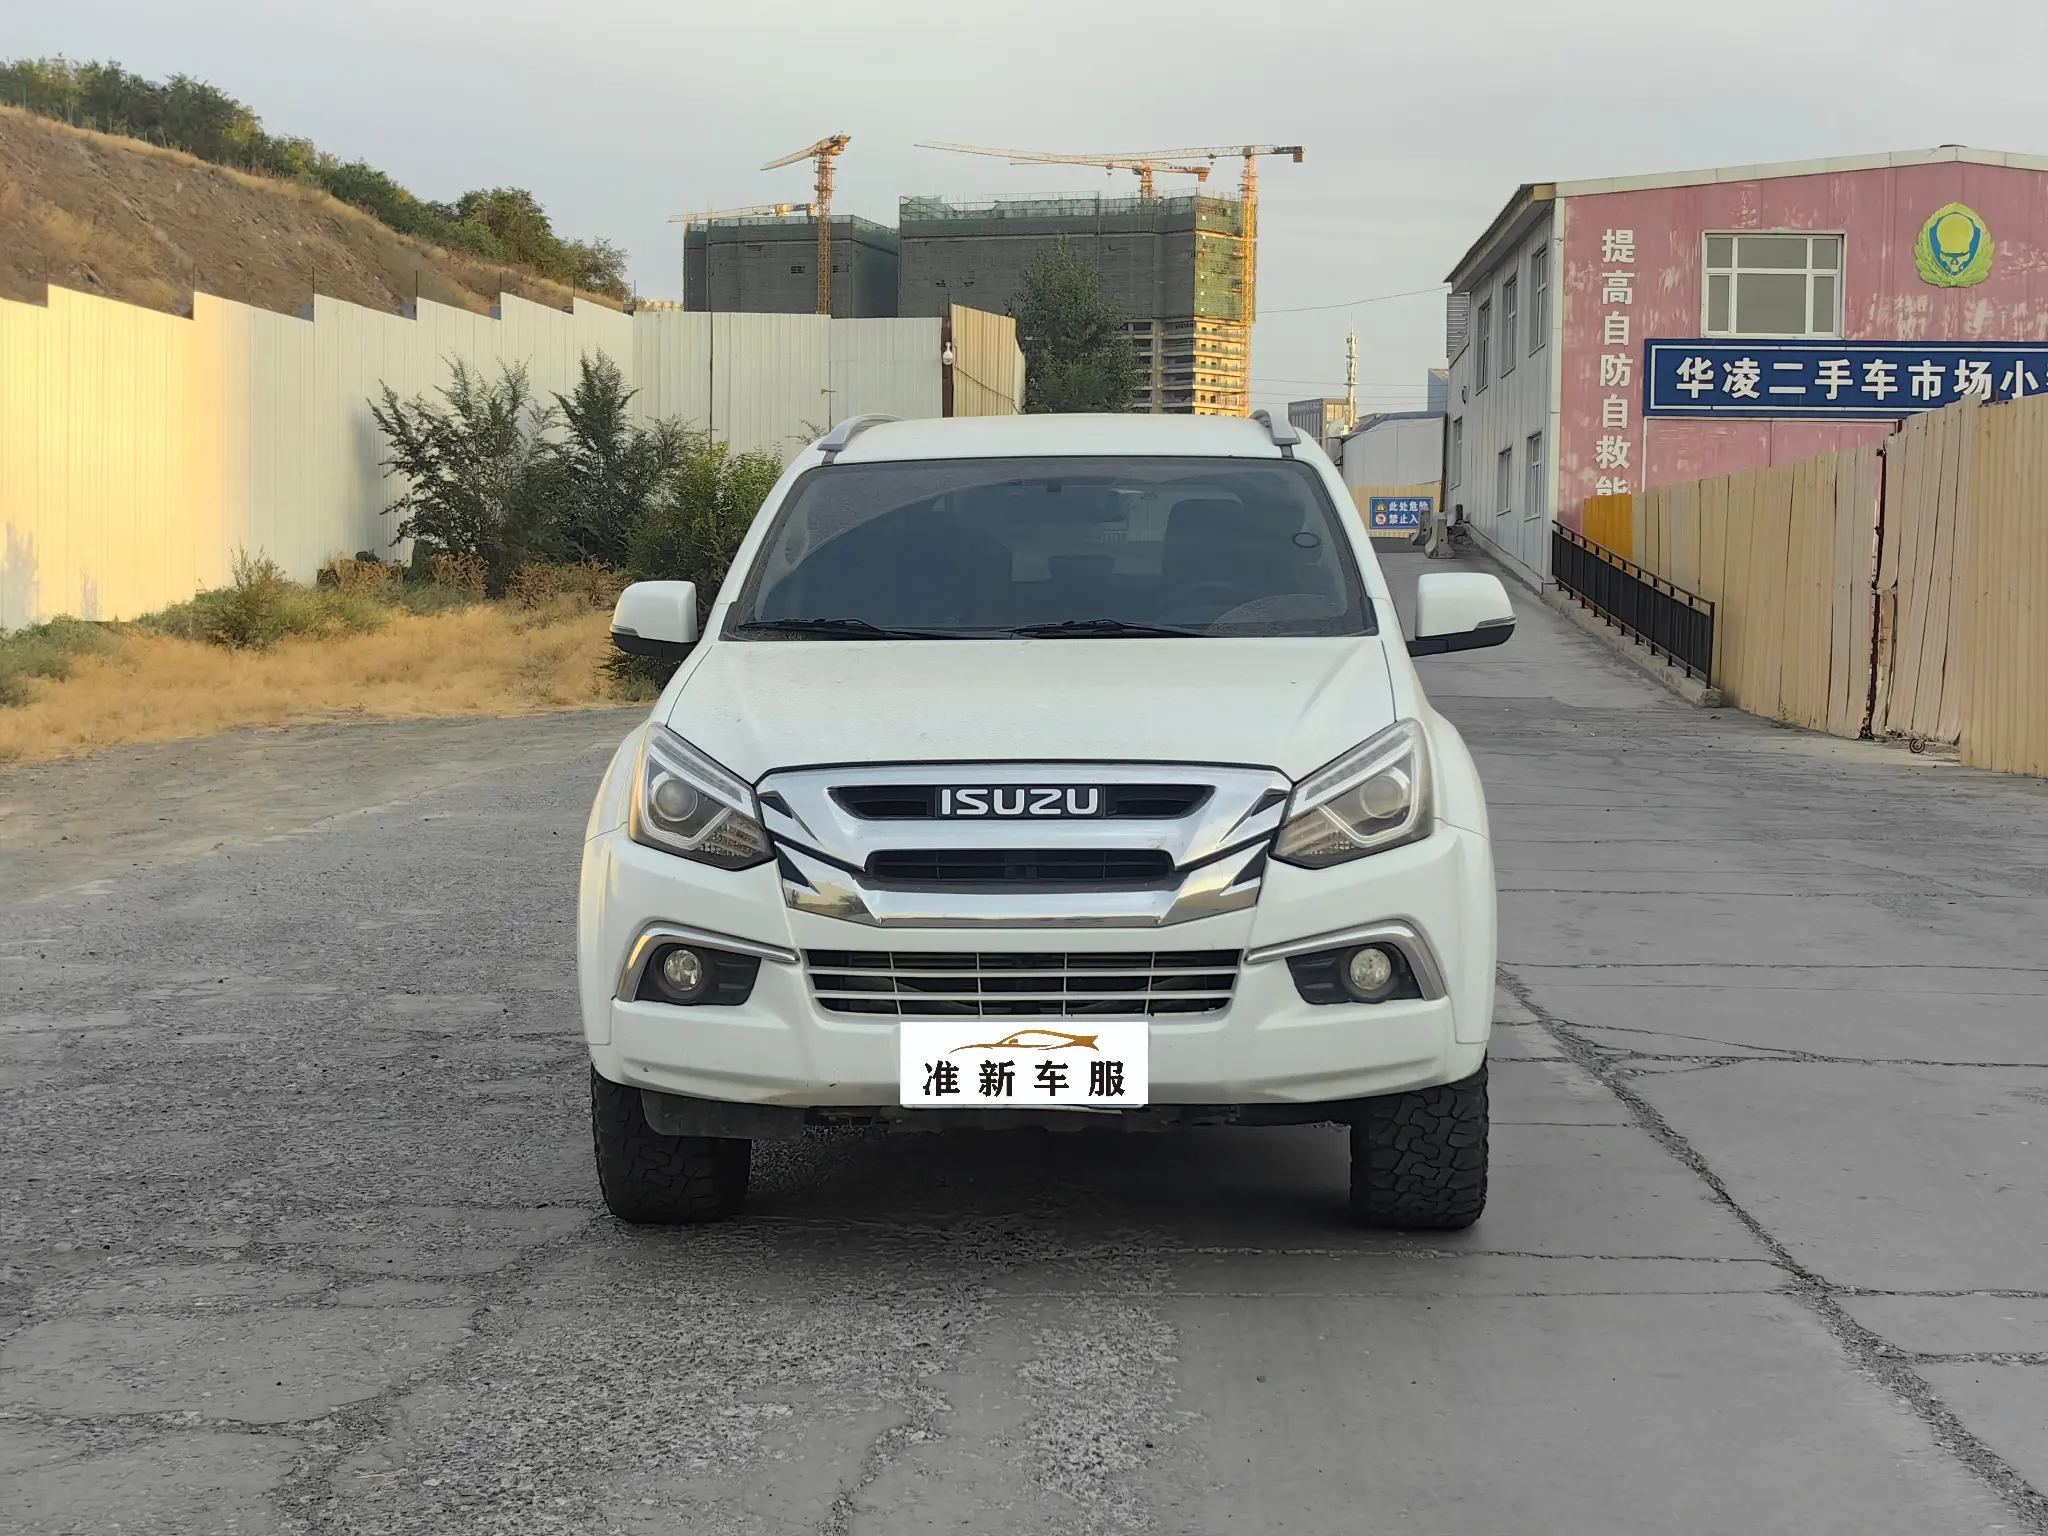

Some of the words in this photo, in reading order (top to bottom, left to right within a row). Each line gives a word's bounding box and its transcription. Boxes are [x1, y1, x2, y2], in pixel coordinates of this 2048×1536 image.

[1676, 357, 2048, 400] 华凌二手车市场小
[941, 788, 1098, 815] ISUZU
